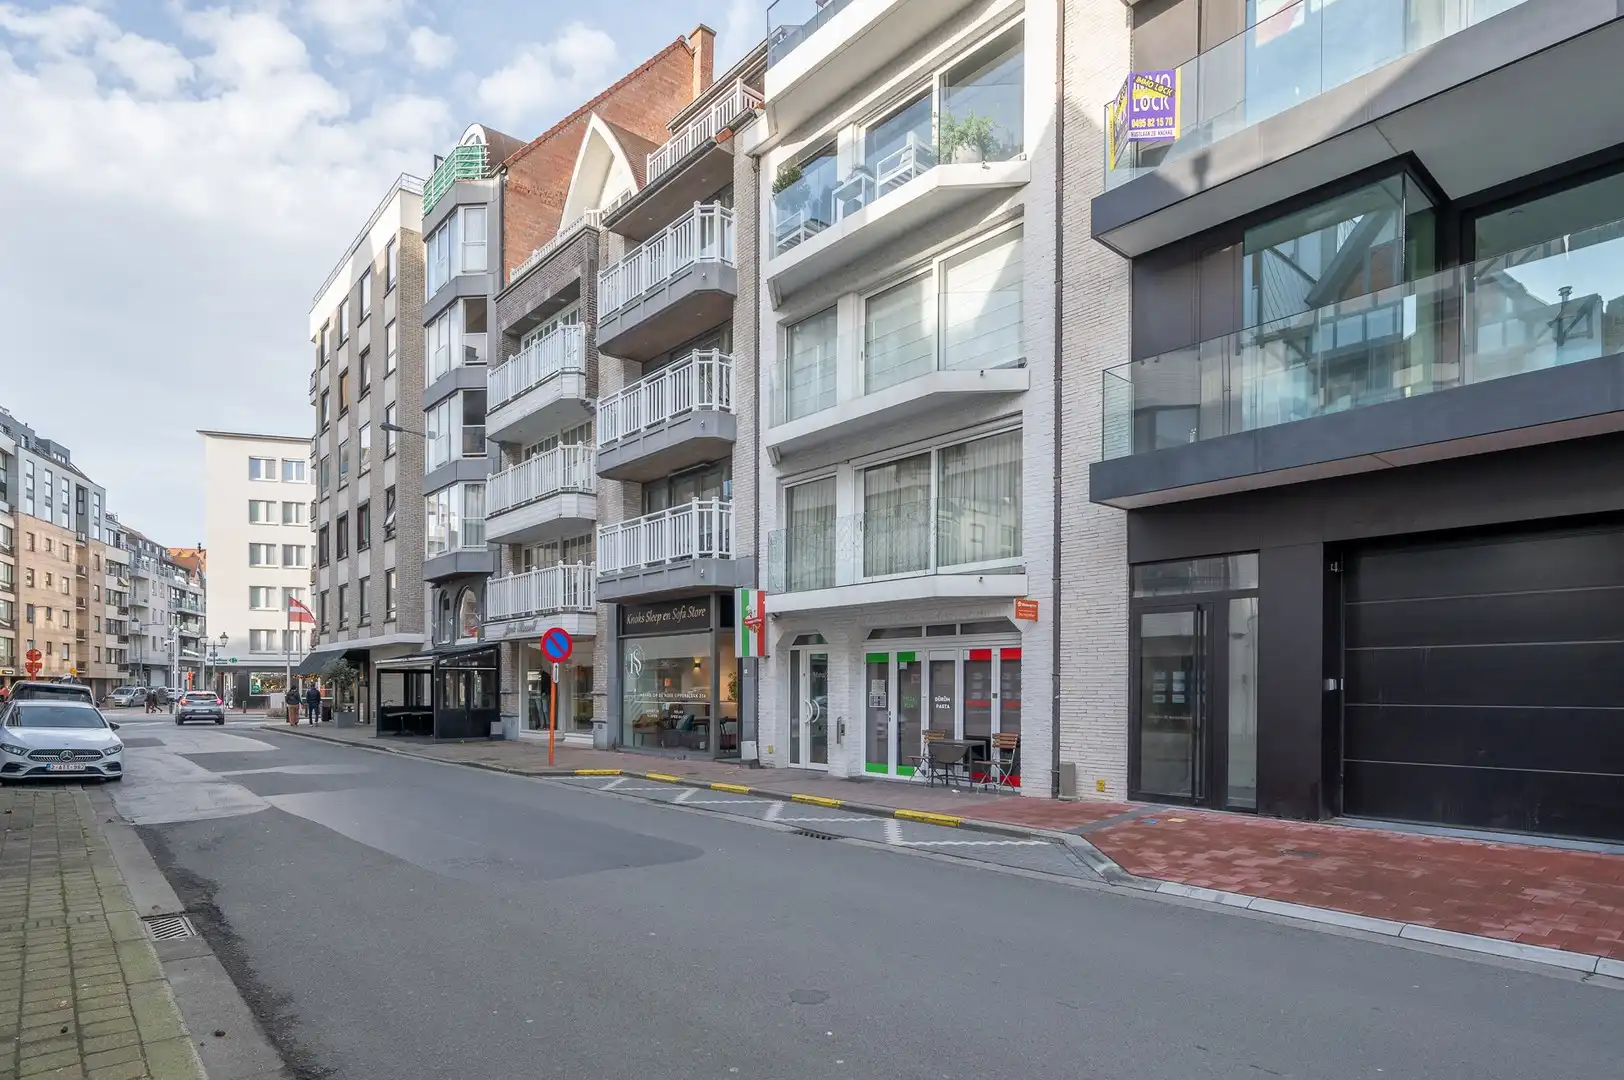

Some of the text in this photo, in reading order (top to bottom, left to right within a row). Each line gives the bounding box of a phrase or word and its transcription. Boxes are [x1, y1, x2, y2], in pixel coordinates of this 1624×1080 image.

[1135, 76, 1173, 96] IMMO LOCK
[1133, 95, 1170, 112] LOCK
[1164, 116, 1173, 126] 70
[645, 609, 662, 625] Sleep
[662, 612, 671, 620] en
[672, 605, 687, 623] Sofa
[687, 605, 706, 618] Store
